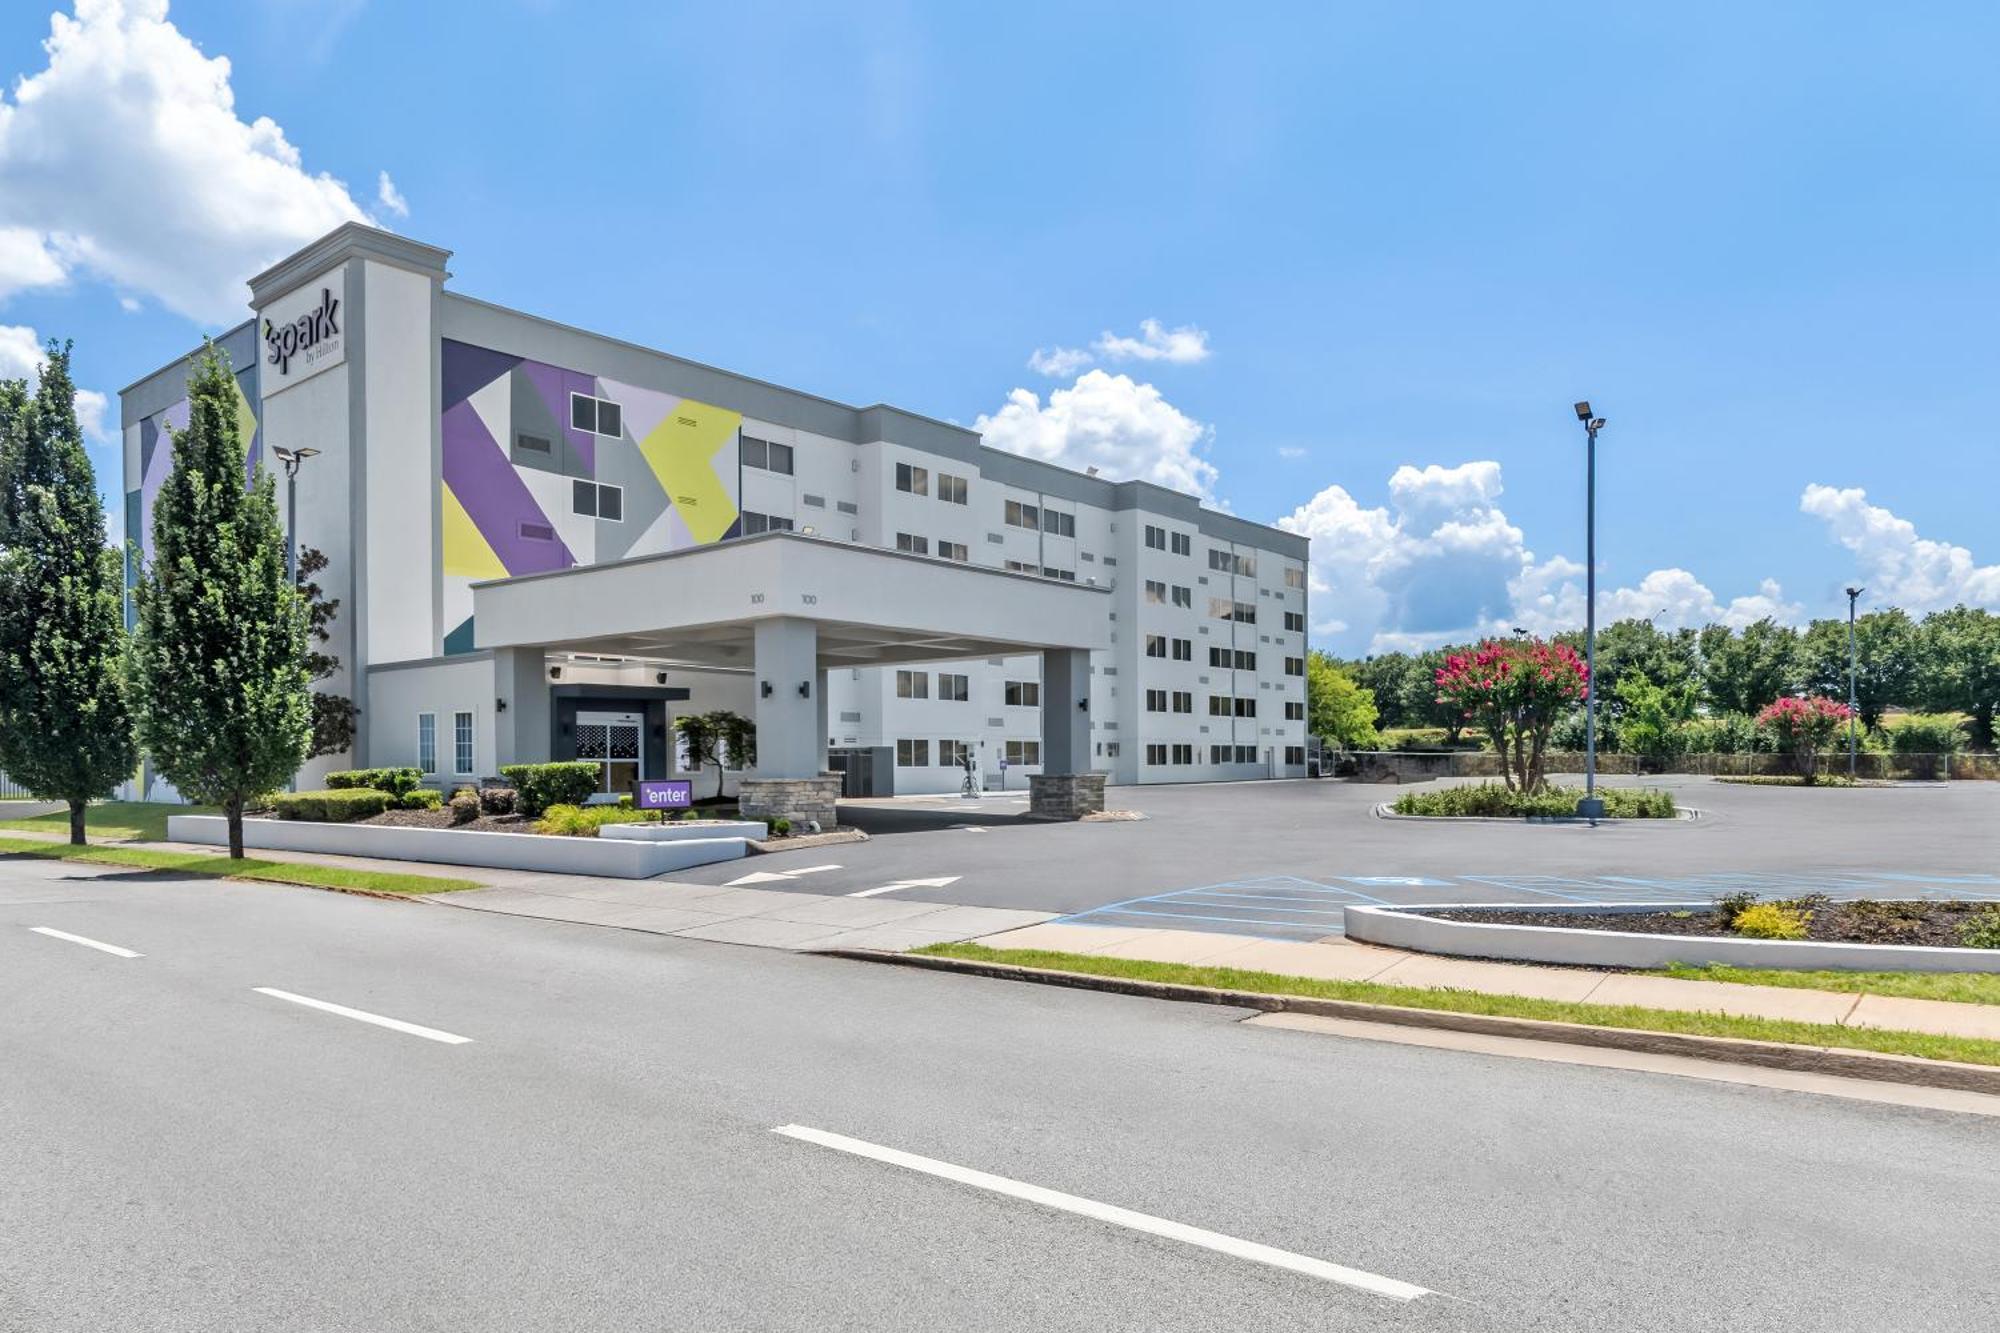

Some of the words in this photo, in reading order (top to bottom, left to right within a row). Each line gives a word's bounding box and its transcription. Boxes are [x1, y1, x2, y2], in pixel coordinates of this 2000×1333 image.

[267, 288, 339, 375] spark
[306, 349, 314, 366] by
[315, 340, 339, 360] Hilton
[751, 593, 765, 604] 100
[801, 594, 817, 605] 100
[648, 788, 687, 803] enter
